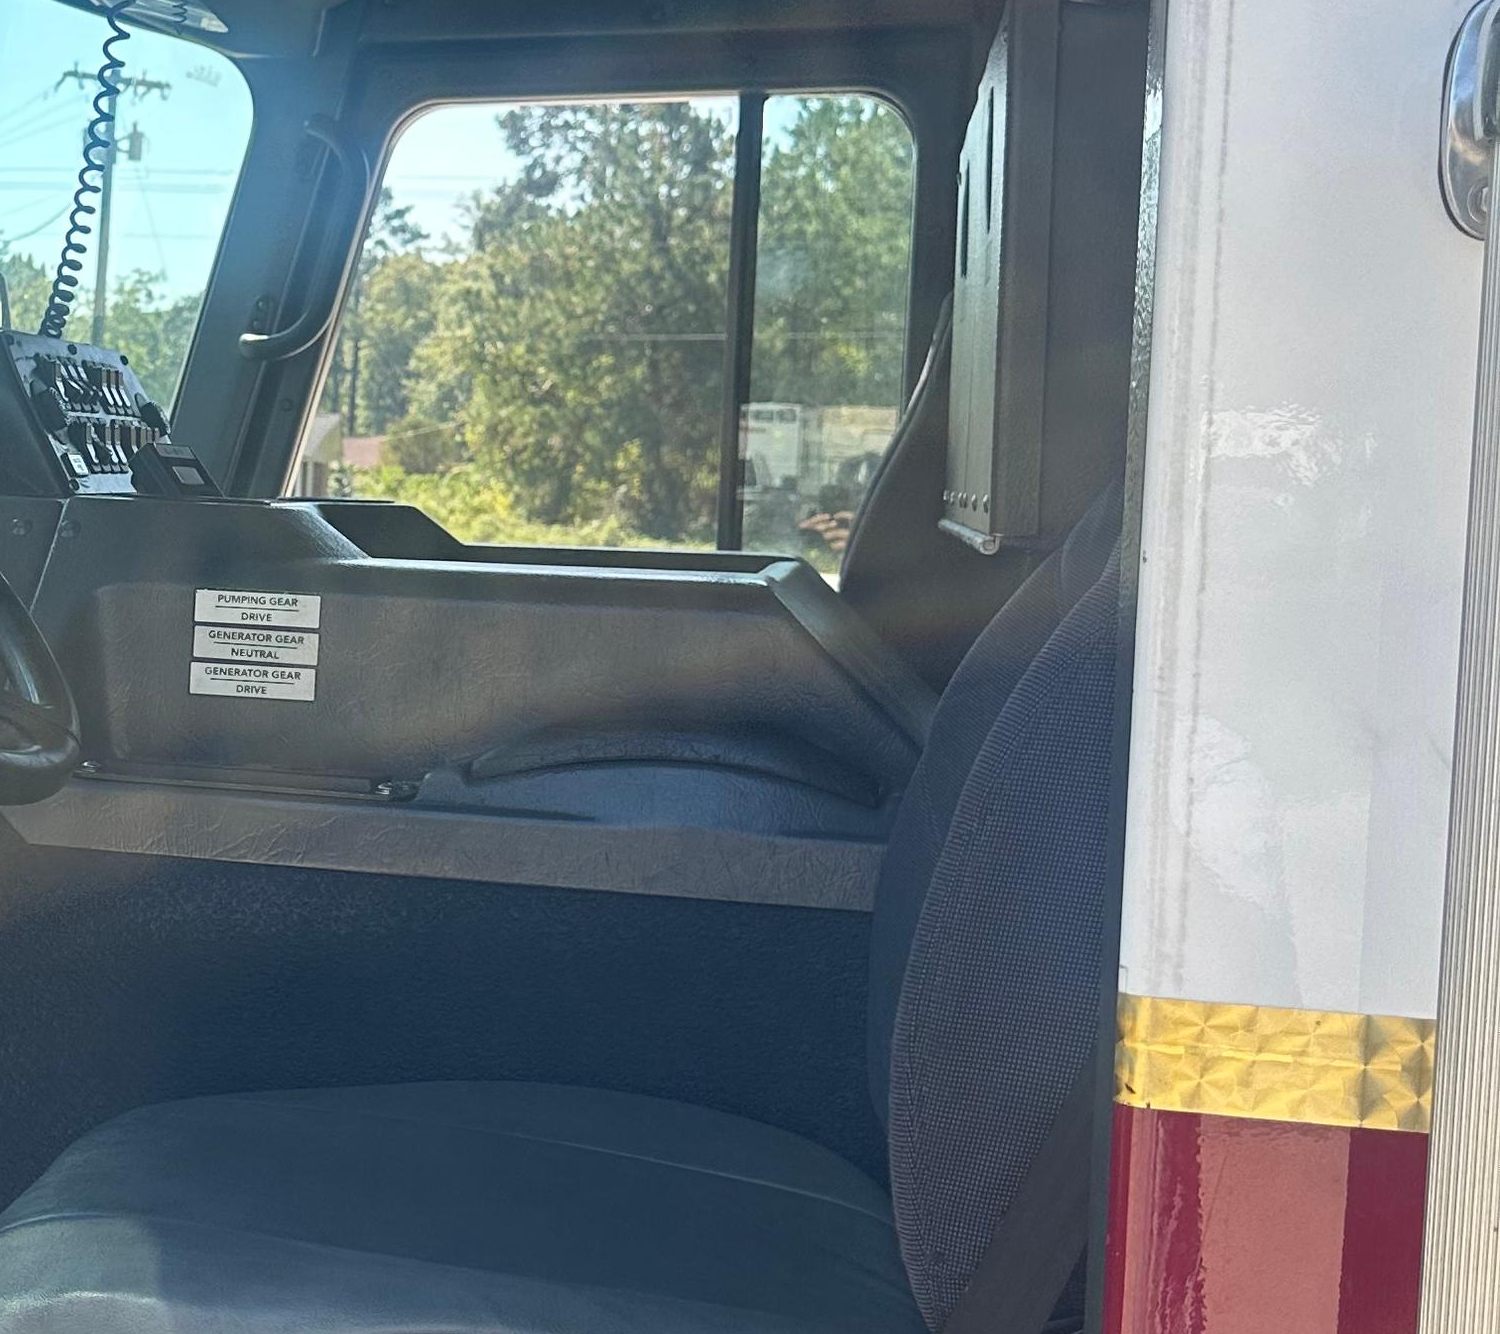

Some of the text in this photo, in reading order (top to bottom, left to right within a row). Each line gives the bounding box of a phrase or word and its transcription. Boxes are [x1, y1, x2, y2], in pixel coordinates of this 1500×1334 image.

[217, 594, 299, 607] PUMPING GEAR
[241, 612, 272, 622] DRIVE
[208, 630, 305, 645] GENERATOR GEAR
[231, 648, 280, 660] NEUTRAL
[204, 667, 301, 680] GENERATOR GEAR
[236, 685, 267, 694] DRIVE
